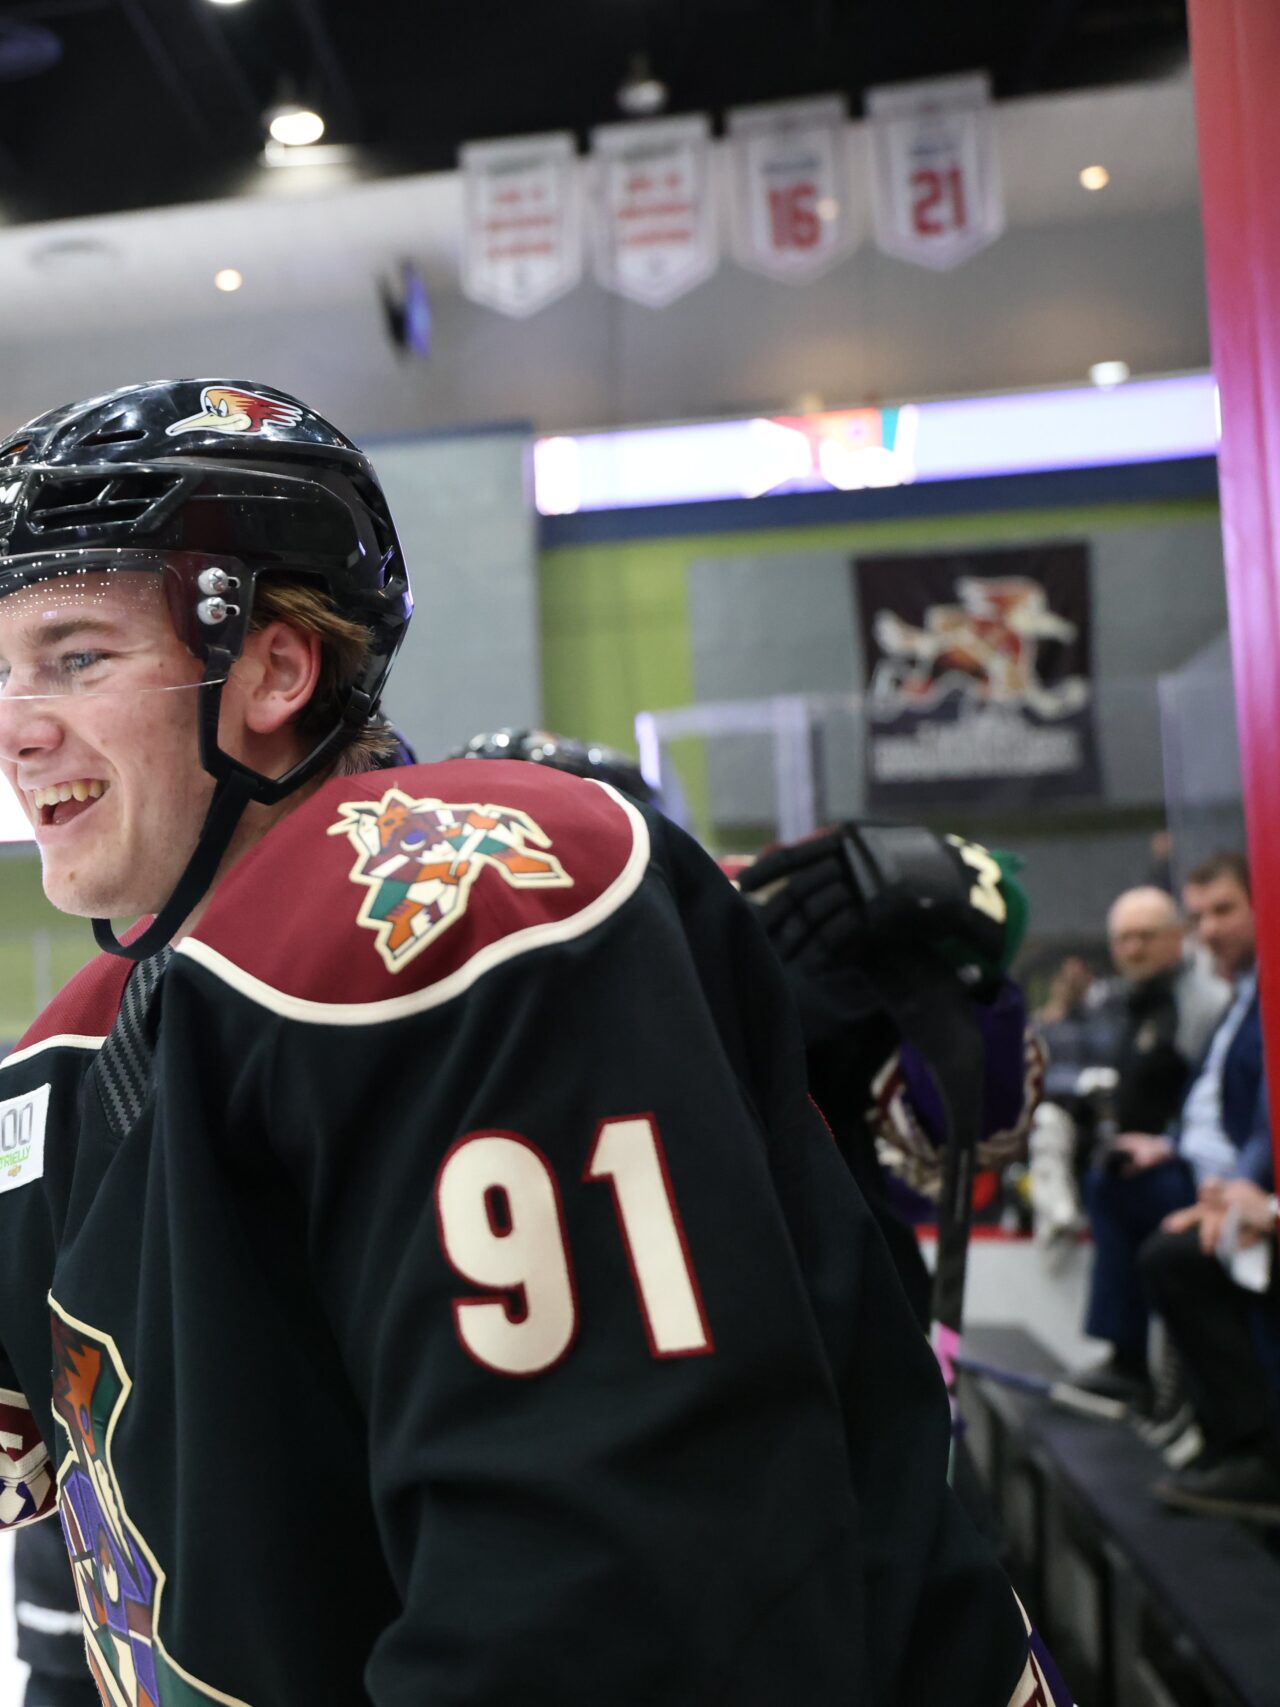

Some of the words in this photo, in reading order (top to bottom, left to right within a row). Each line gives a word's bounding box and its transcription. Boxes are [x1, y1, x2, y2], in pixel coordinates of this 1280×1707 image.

[766, 179, 823, 250] 16
[909, 163, 968, 237] 21
[434, 1111, 717, 1380] 91
